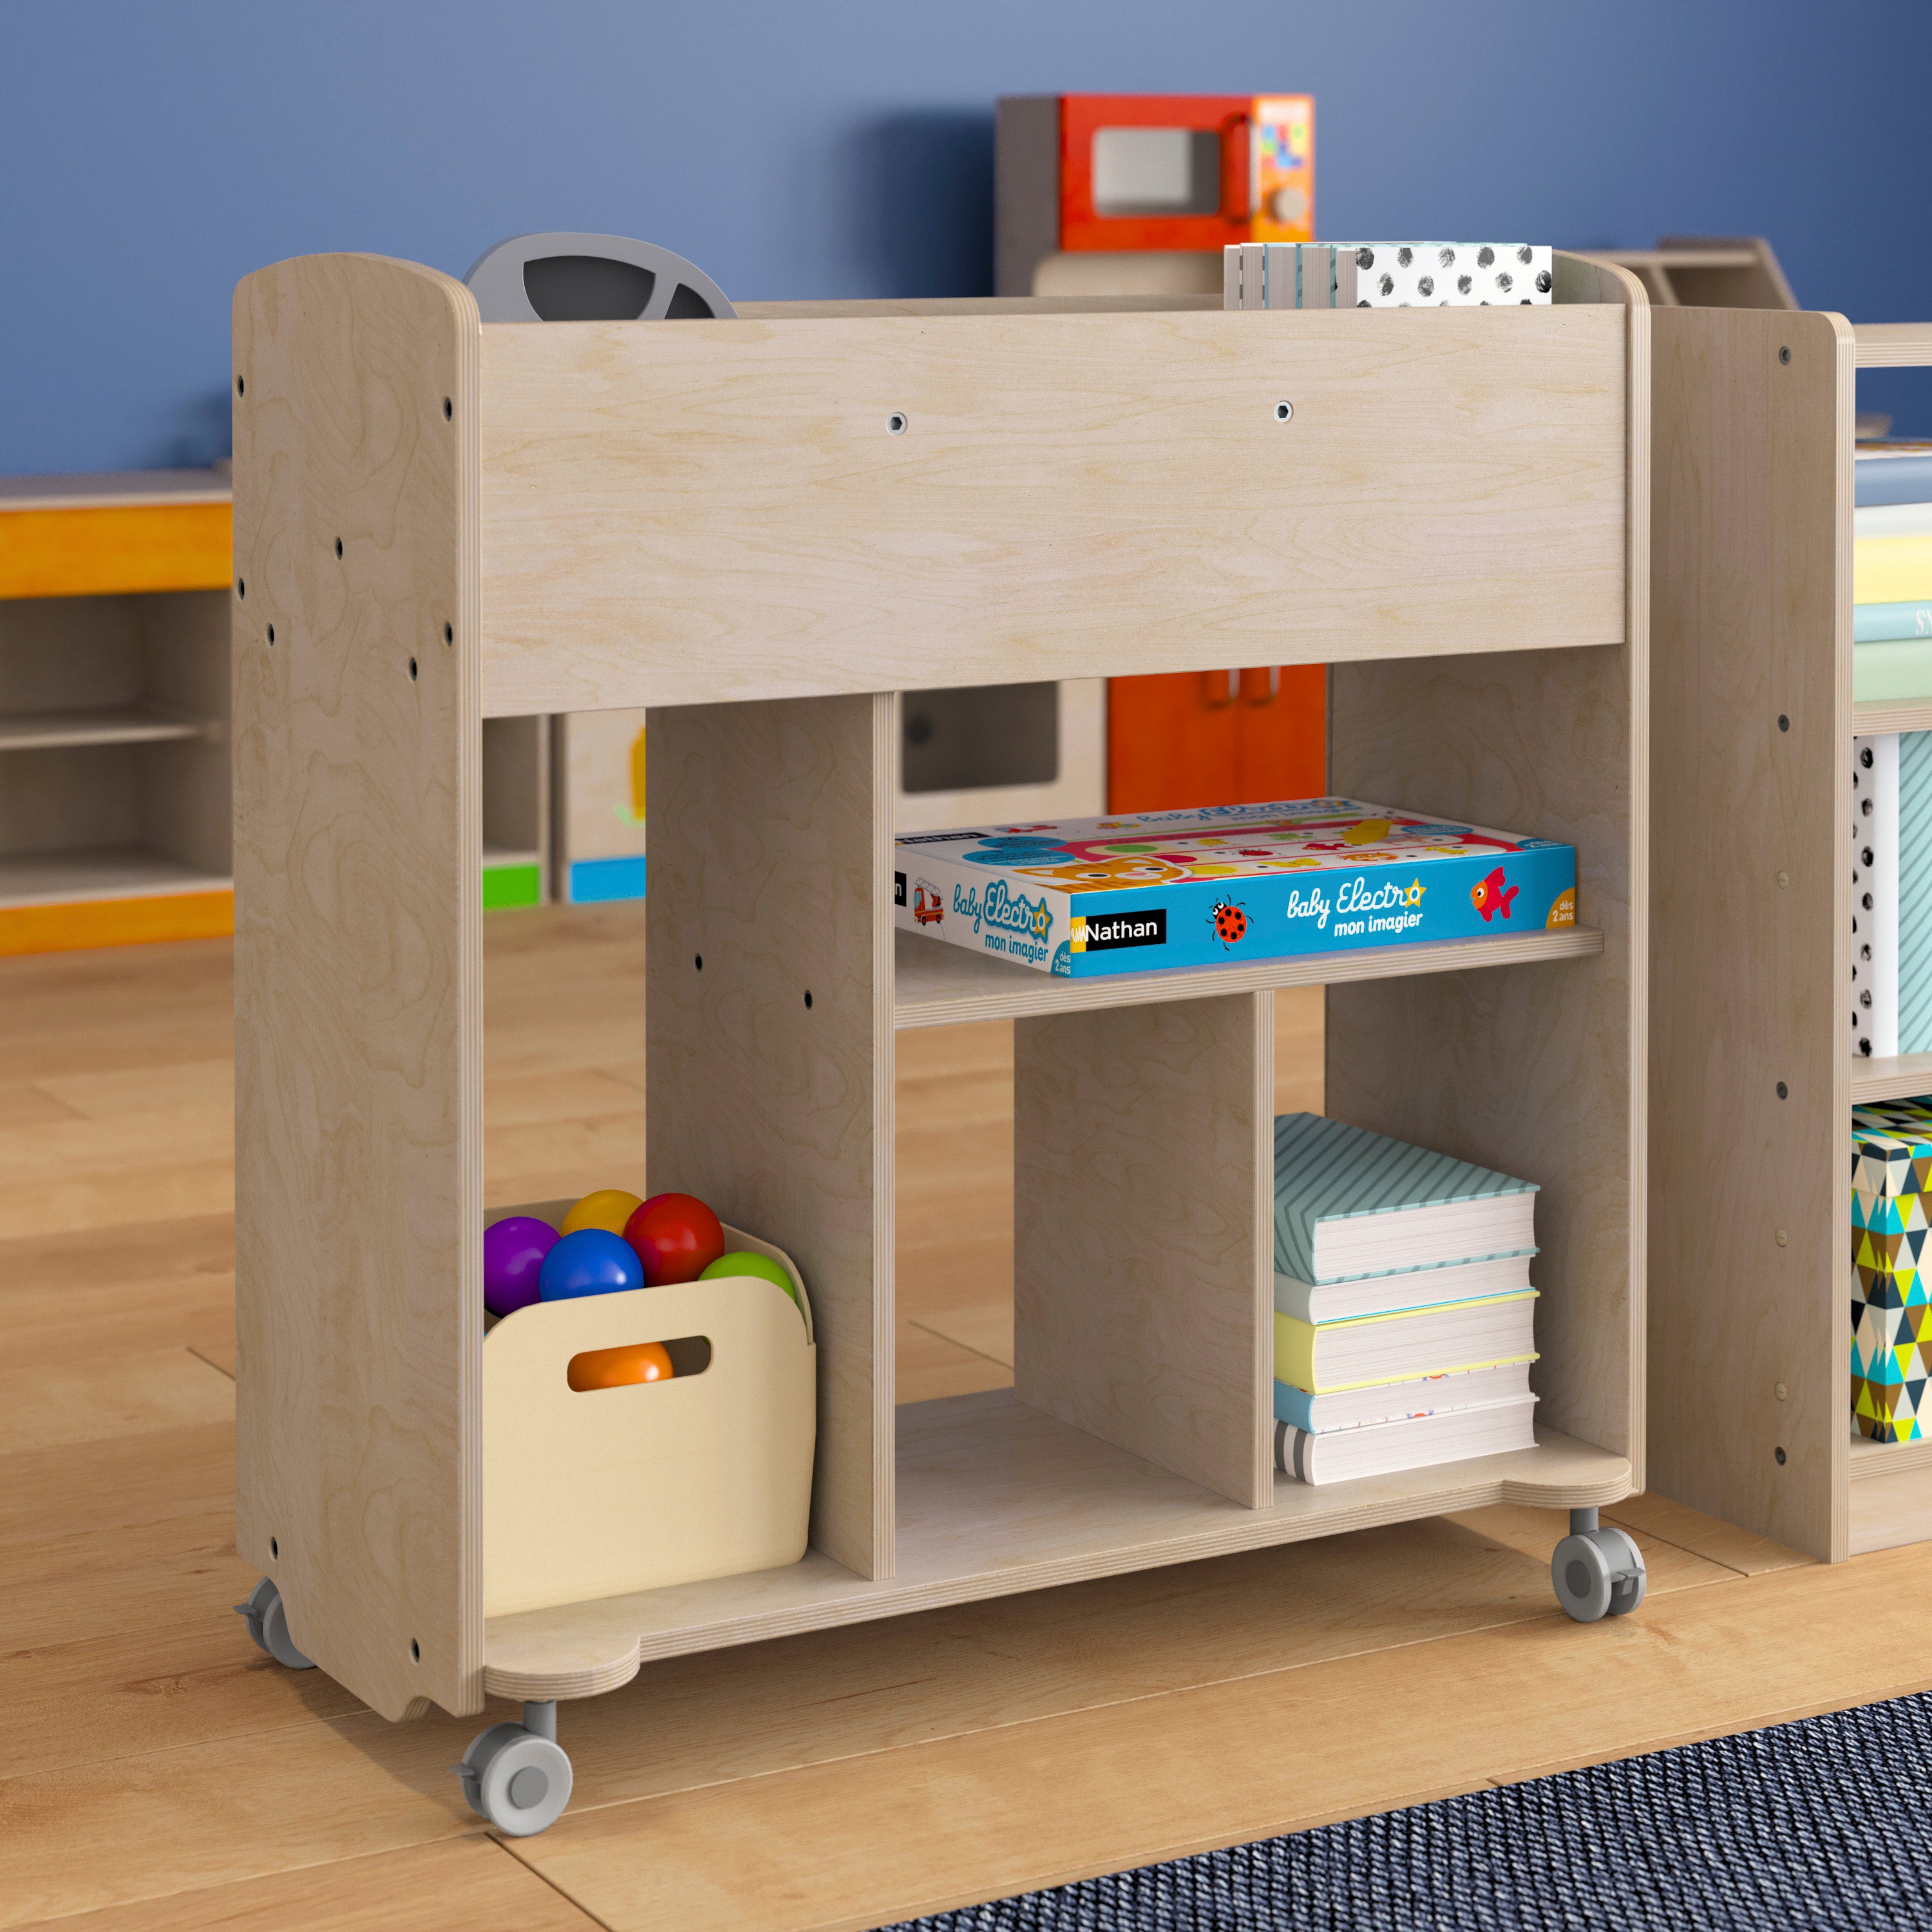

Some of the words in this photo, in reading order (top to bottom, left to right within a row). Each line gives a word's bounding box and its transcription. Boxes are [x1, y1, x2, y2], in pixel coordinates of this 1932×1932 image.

[953, 883, 983, 934] baby
[984, 880, 1050, 940] Electro
[1287, 888, 1331, 930] baby
[1336, 876, 1425, 911] Electro
[1559, 900, 1574, 911] dès
[1334, 921, 1365, 937] mon
[1368, 911, 1423, 934] imagier
[1553, 910, 1558, 922] 2
[1558, 911, 1574, 922] ans
[1084, 920, 1158, 942] Nathan
[985, 933, 1007, 953] mon
[1009, 935, 1049, 964] imagier
[1060, 951, 1071, 963] dès
[1055, 960, 1059, 971] 2
[1059, 964, 1071, 974] ans
